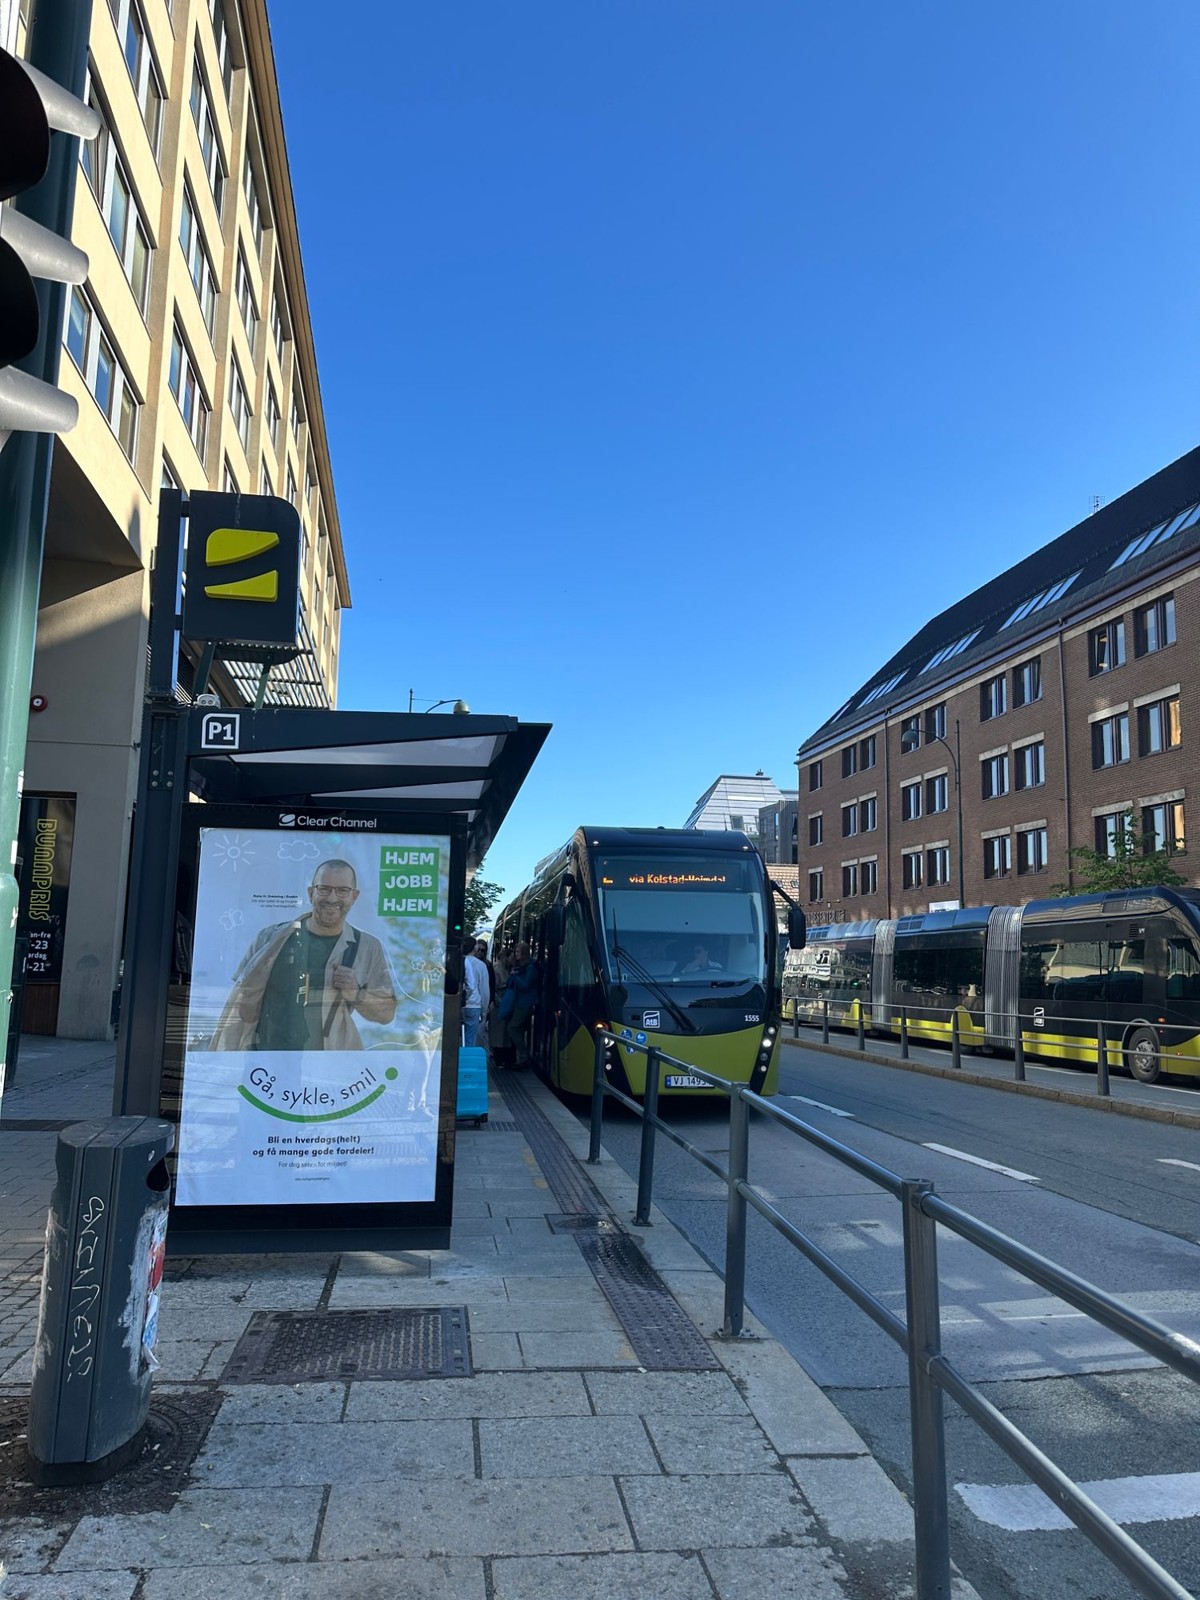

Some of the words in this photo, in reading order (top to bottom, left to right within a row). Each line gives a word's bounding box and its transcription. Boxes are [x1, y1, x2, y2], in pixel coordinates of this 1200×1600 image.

[208, 721, 234, 741] P1
[296, 815, 327, 827] Clear
[330, 816, 378, 829] Channel
[385, 851, 435, 866] HJEM
[28, 818, 58, 922] BUNNPRIS
[385, 874, 433, 889] JOBB
[629, 874, 644, 884] via
[383, 898, 433, 912] HJEM
[30, 940, 49, 950] -23
[673, 1076, 684, 1086] VJ
[249, 1067, 277, 1100] Gå,
[281, 1087, 336, 1110] sykle,
[340, 1067, 378, 1100] smil
[267, 1136, 280, 1144] Bli
[295, 1135, 361, 1145] hverdags(helt)
[252, 1149, 265, 1157] og
[266, 1147, 277, 1156] få
[279, 1149, 310, 1158] mange
[311, 1147, 335, 1158] gode
[336, 1146, 375, 1155] fordeler!
